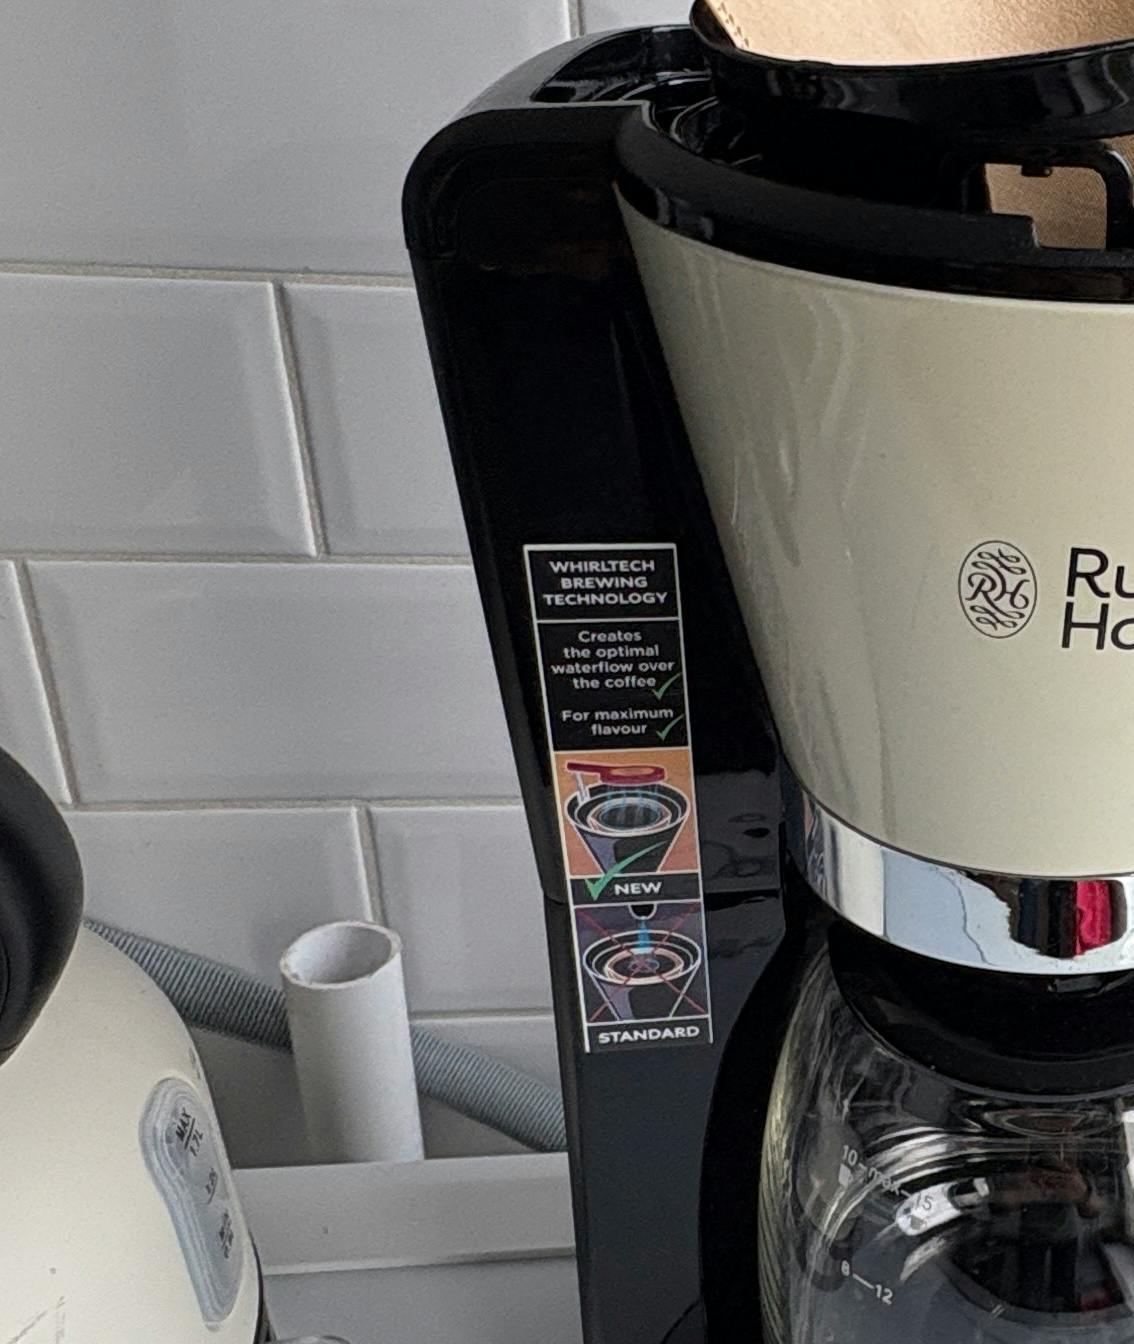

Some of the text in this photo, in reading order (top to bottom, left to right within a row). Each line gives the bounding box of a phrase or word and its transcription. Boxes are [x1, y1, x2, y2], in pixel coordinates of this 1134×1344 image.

[548, 560, 655, 573] WHIRLTECH
[560, 576, 648, 589] BREWING
[543, 592, 667, 605] TECHNOLOGY
[578, 630, 642, 643] Creates
[563, 644, 659, 659] the optimal
[550, 661, 676, 674] waterflow over
[573, 674, 657, 689] the coffee
[561, 707, 674, 722] For maximum
[591, 723, 648, 736] flavour
[614, 881, 662, 895] NEW
[598, 1026, 700, 1044] STANDARD
[843, 1145, 858, 1166] 10
[914, 1195, 934, 1211] 15
[840, 1259, 893, 1305] 8 12
